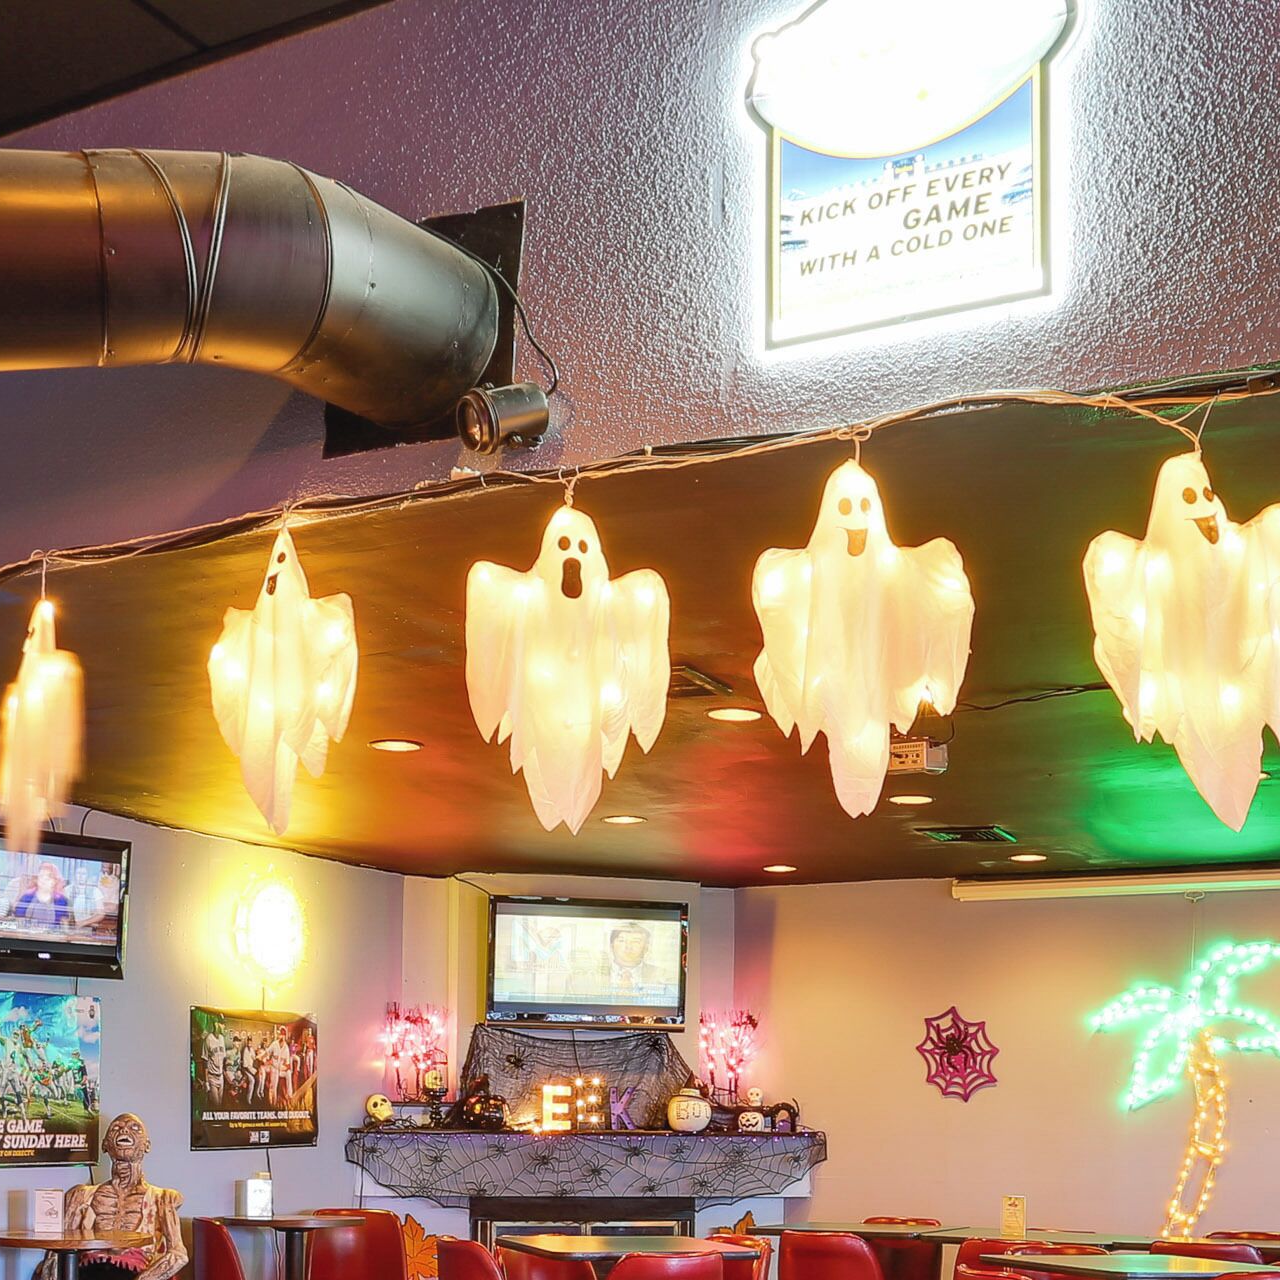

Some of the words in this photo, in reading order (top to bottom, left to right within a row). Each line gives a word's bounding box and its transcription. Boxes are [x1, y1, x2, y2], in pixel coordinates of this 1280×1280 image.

[799, 197, 858, 227] KICK
[868, 184, 917, 210] OFF
[926, 162, 1013, 198] EVERY
[903, 192, 993, 230] GAME
[799, 250, 858, 276] WITH
[866, 245, 881, 262] A
[890, 229, 953, 257] COLD
[963, 215, 1014, 241] ONE
[202, 1111, 214, 1120] ALL
[214, 1111, 230, 1120] YOUR
[230, 1111, 257, 1120] FAVORITE
[542, 1078, 637, 1131] EEK
[2, 1134, 53, 1149] SUNDAY
[53, 1134, 89, 1149] HERE.
[6, 1119, 45, 1134] GAME.
